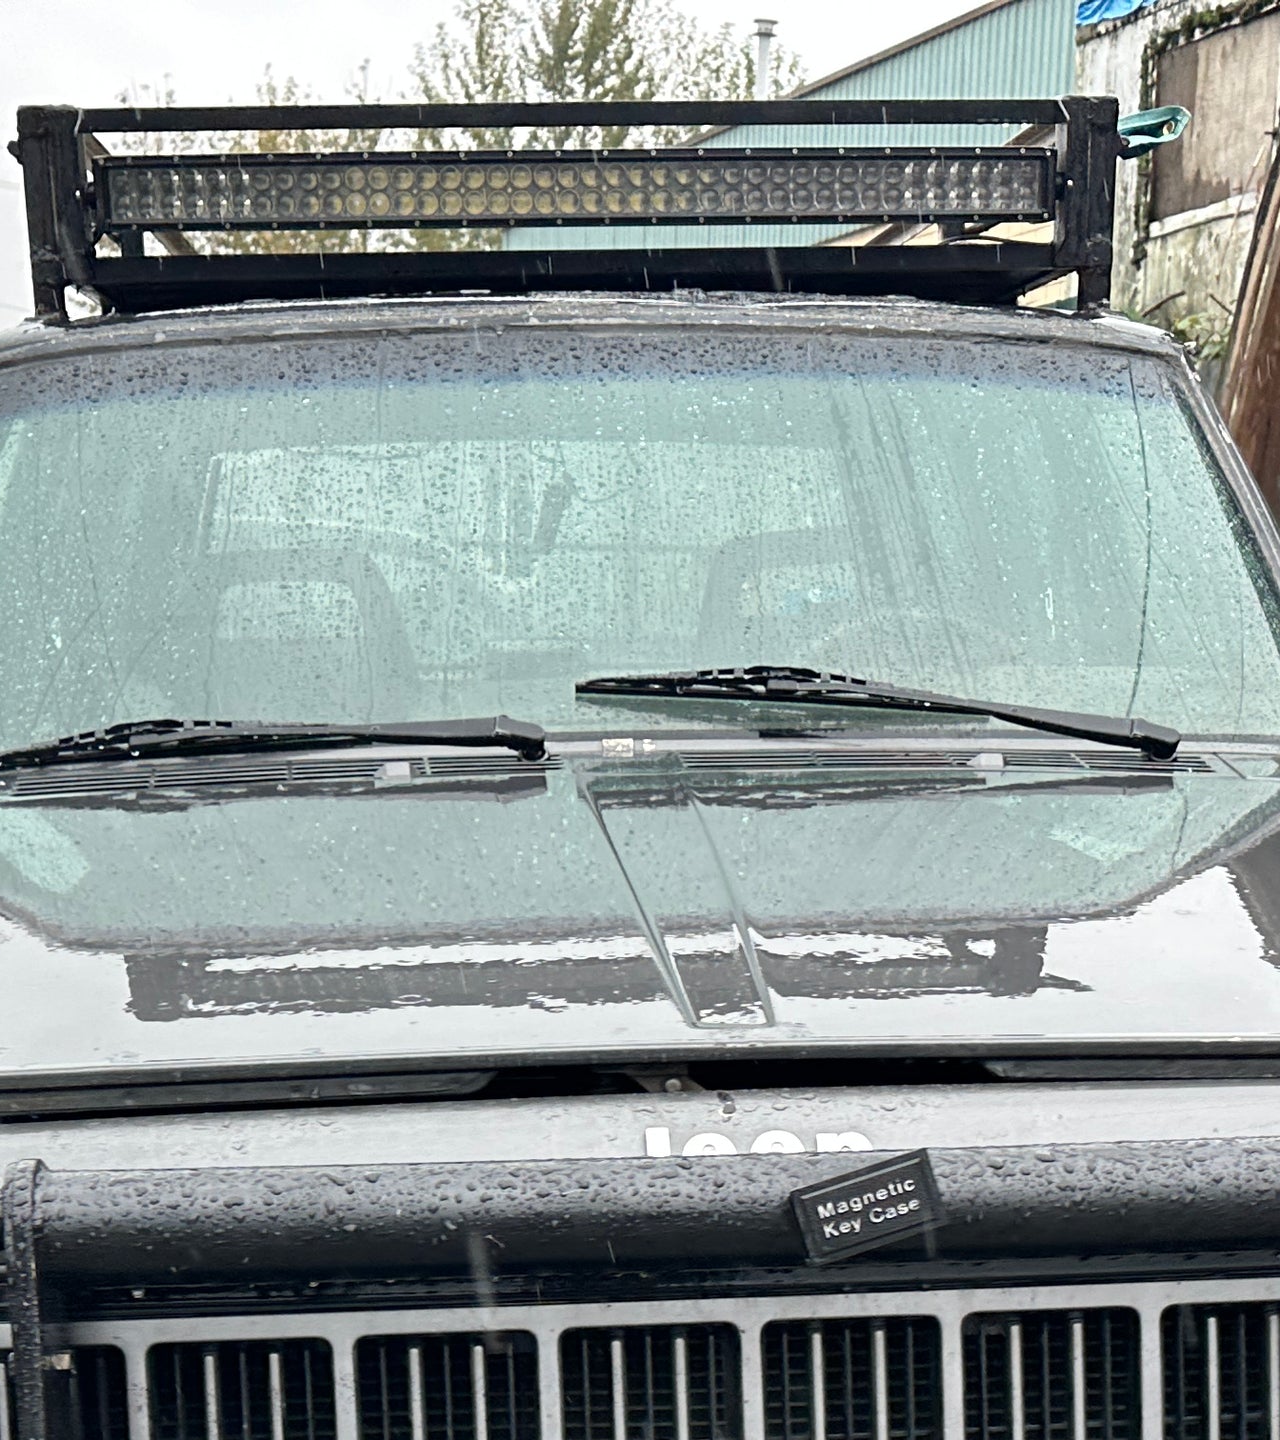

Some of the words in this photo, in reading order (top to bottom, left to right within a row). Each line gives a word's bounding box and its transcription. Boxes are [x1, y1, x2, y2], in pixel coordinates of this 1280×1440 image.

[817, 1179, 916, 1219] Magnetic
[823, 1219, 861, 1239] Key
[869, 1199, 920, 1223] Case
